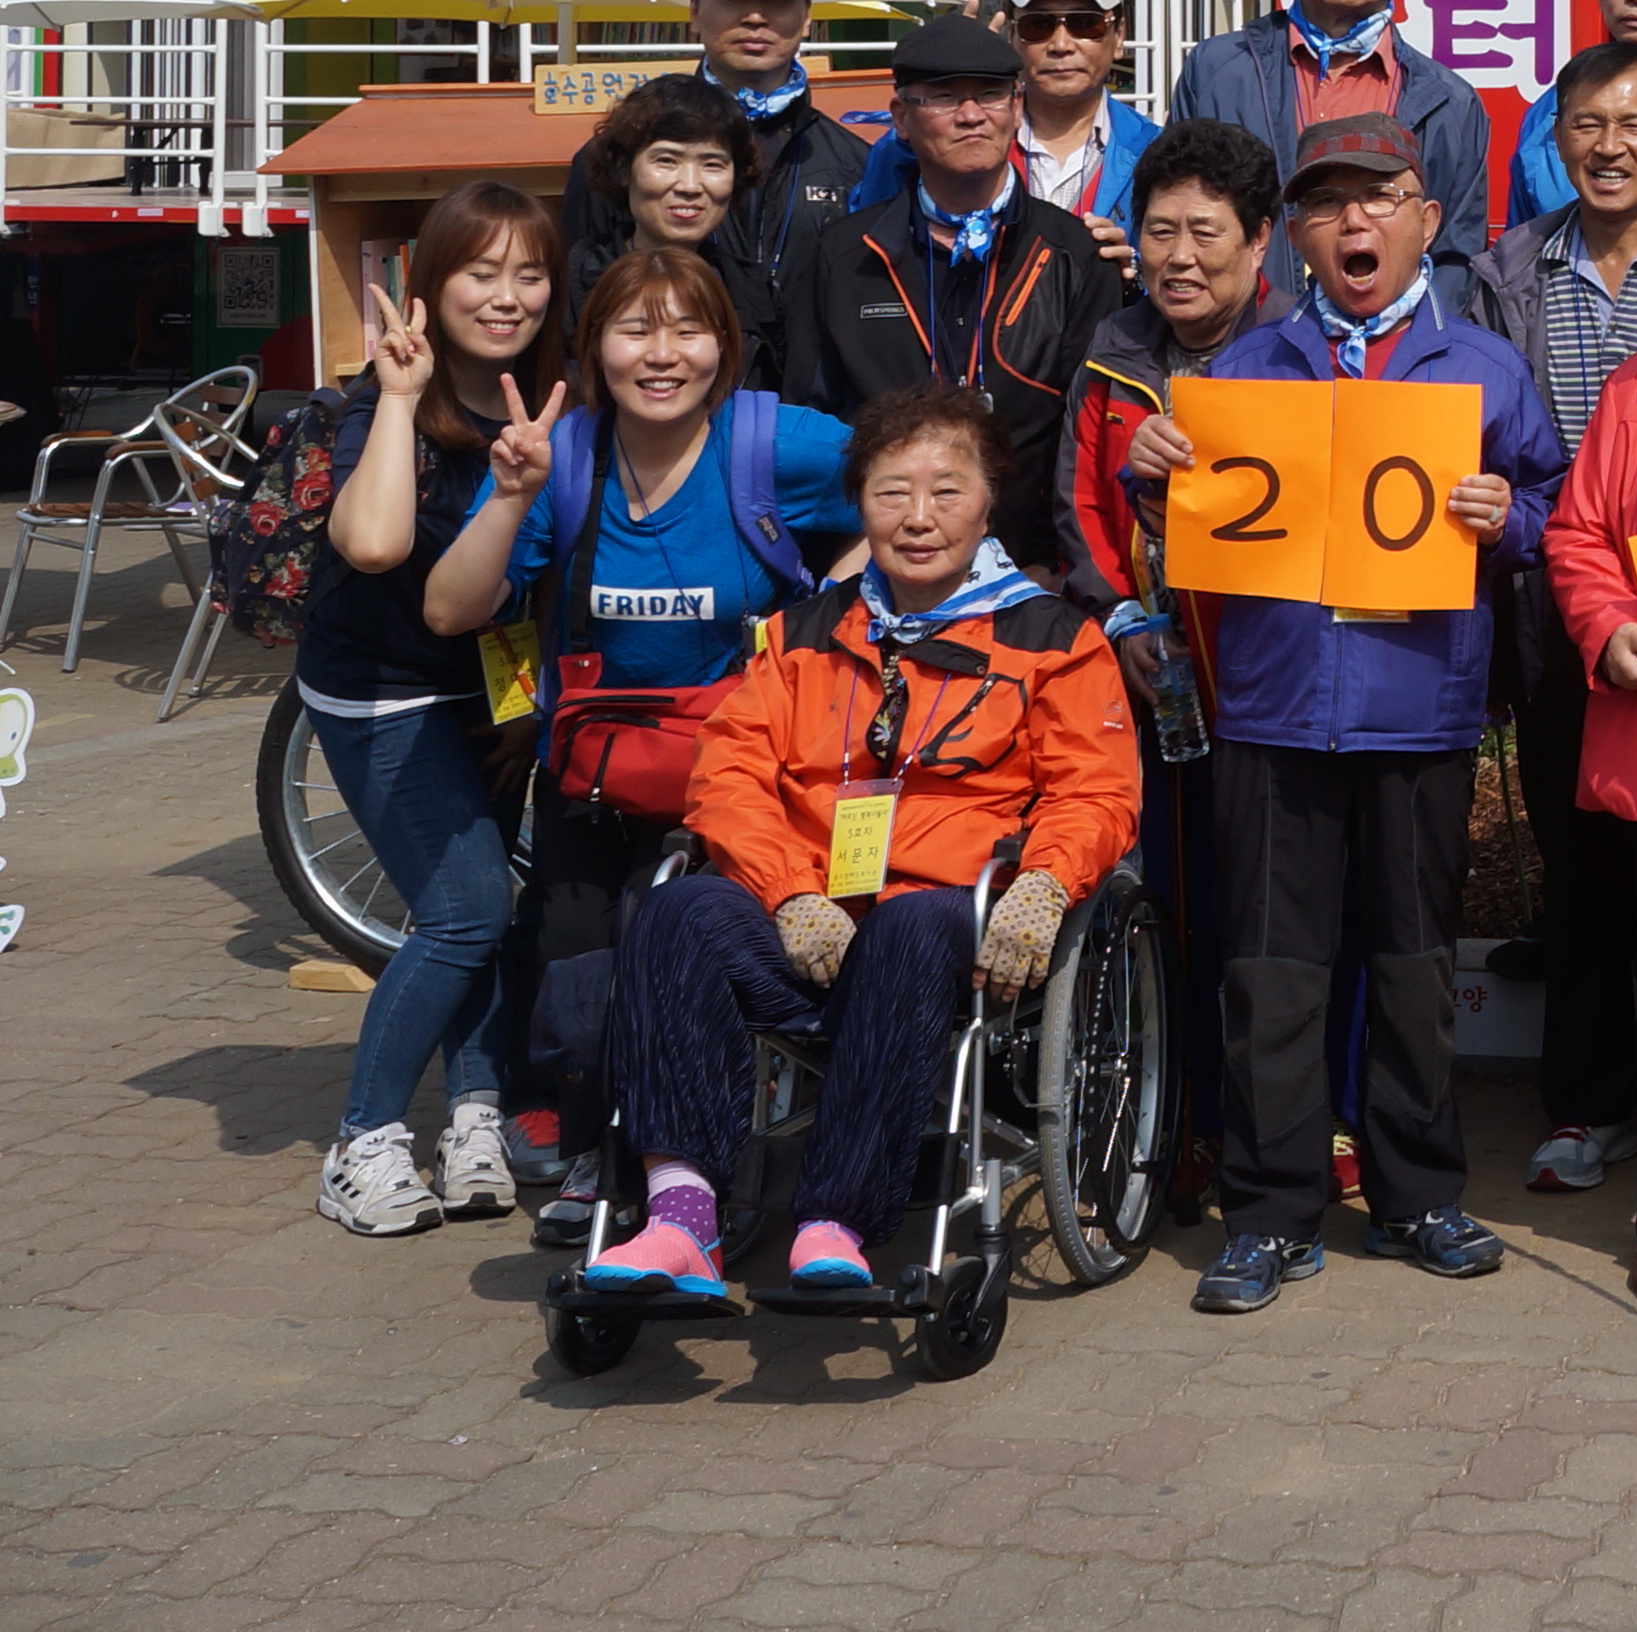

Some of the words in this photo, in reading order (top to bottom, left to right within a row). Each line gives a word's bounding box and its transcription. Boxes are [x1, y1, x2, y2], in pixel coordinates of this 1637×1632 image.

[1210, 456, 1288, 542] 2
[1362, 455, 1436, 552] 0
[598, 592, 705, 617] FRIDAY
